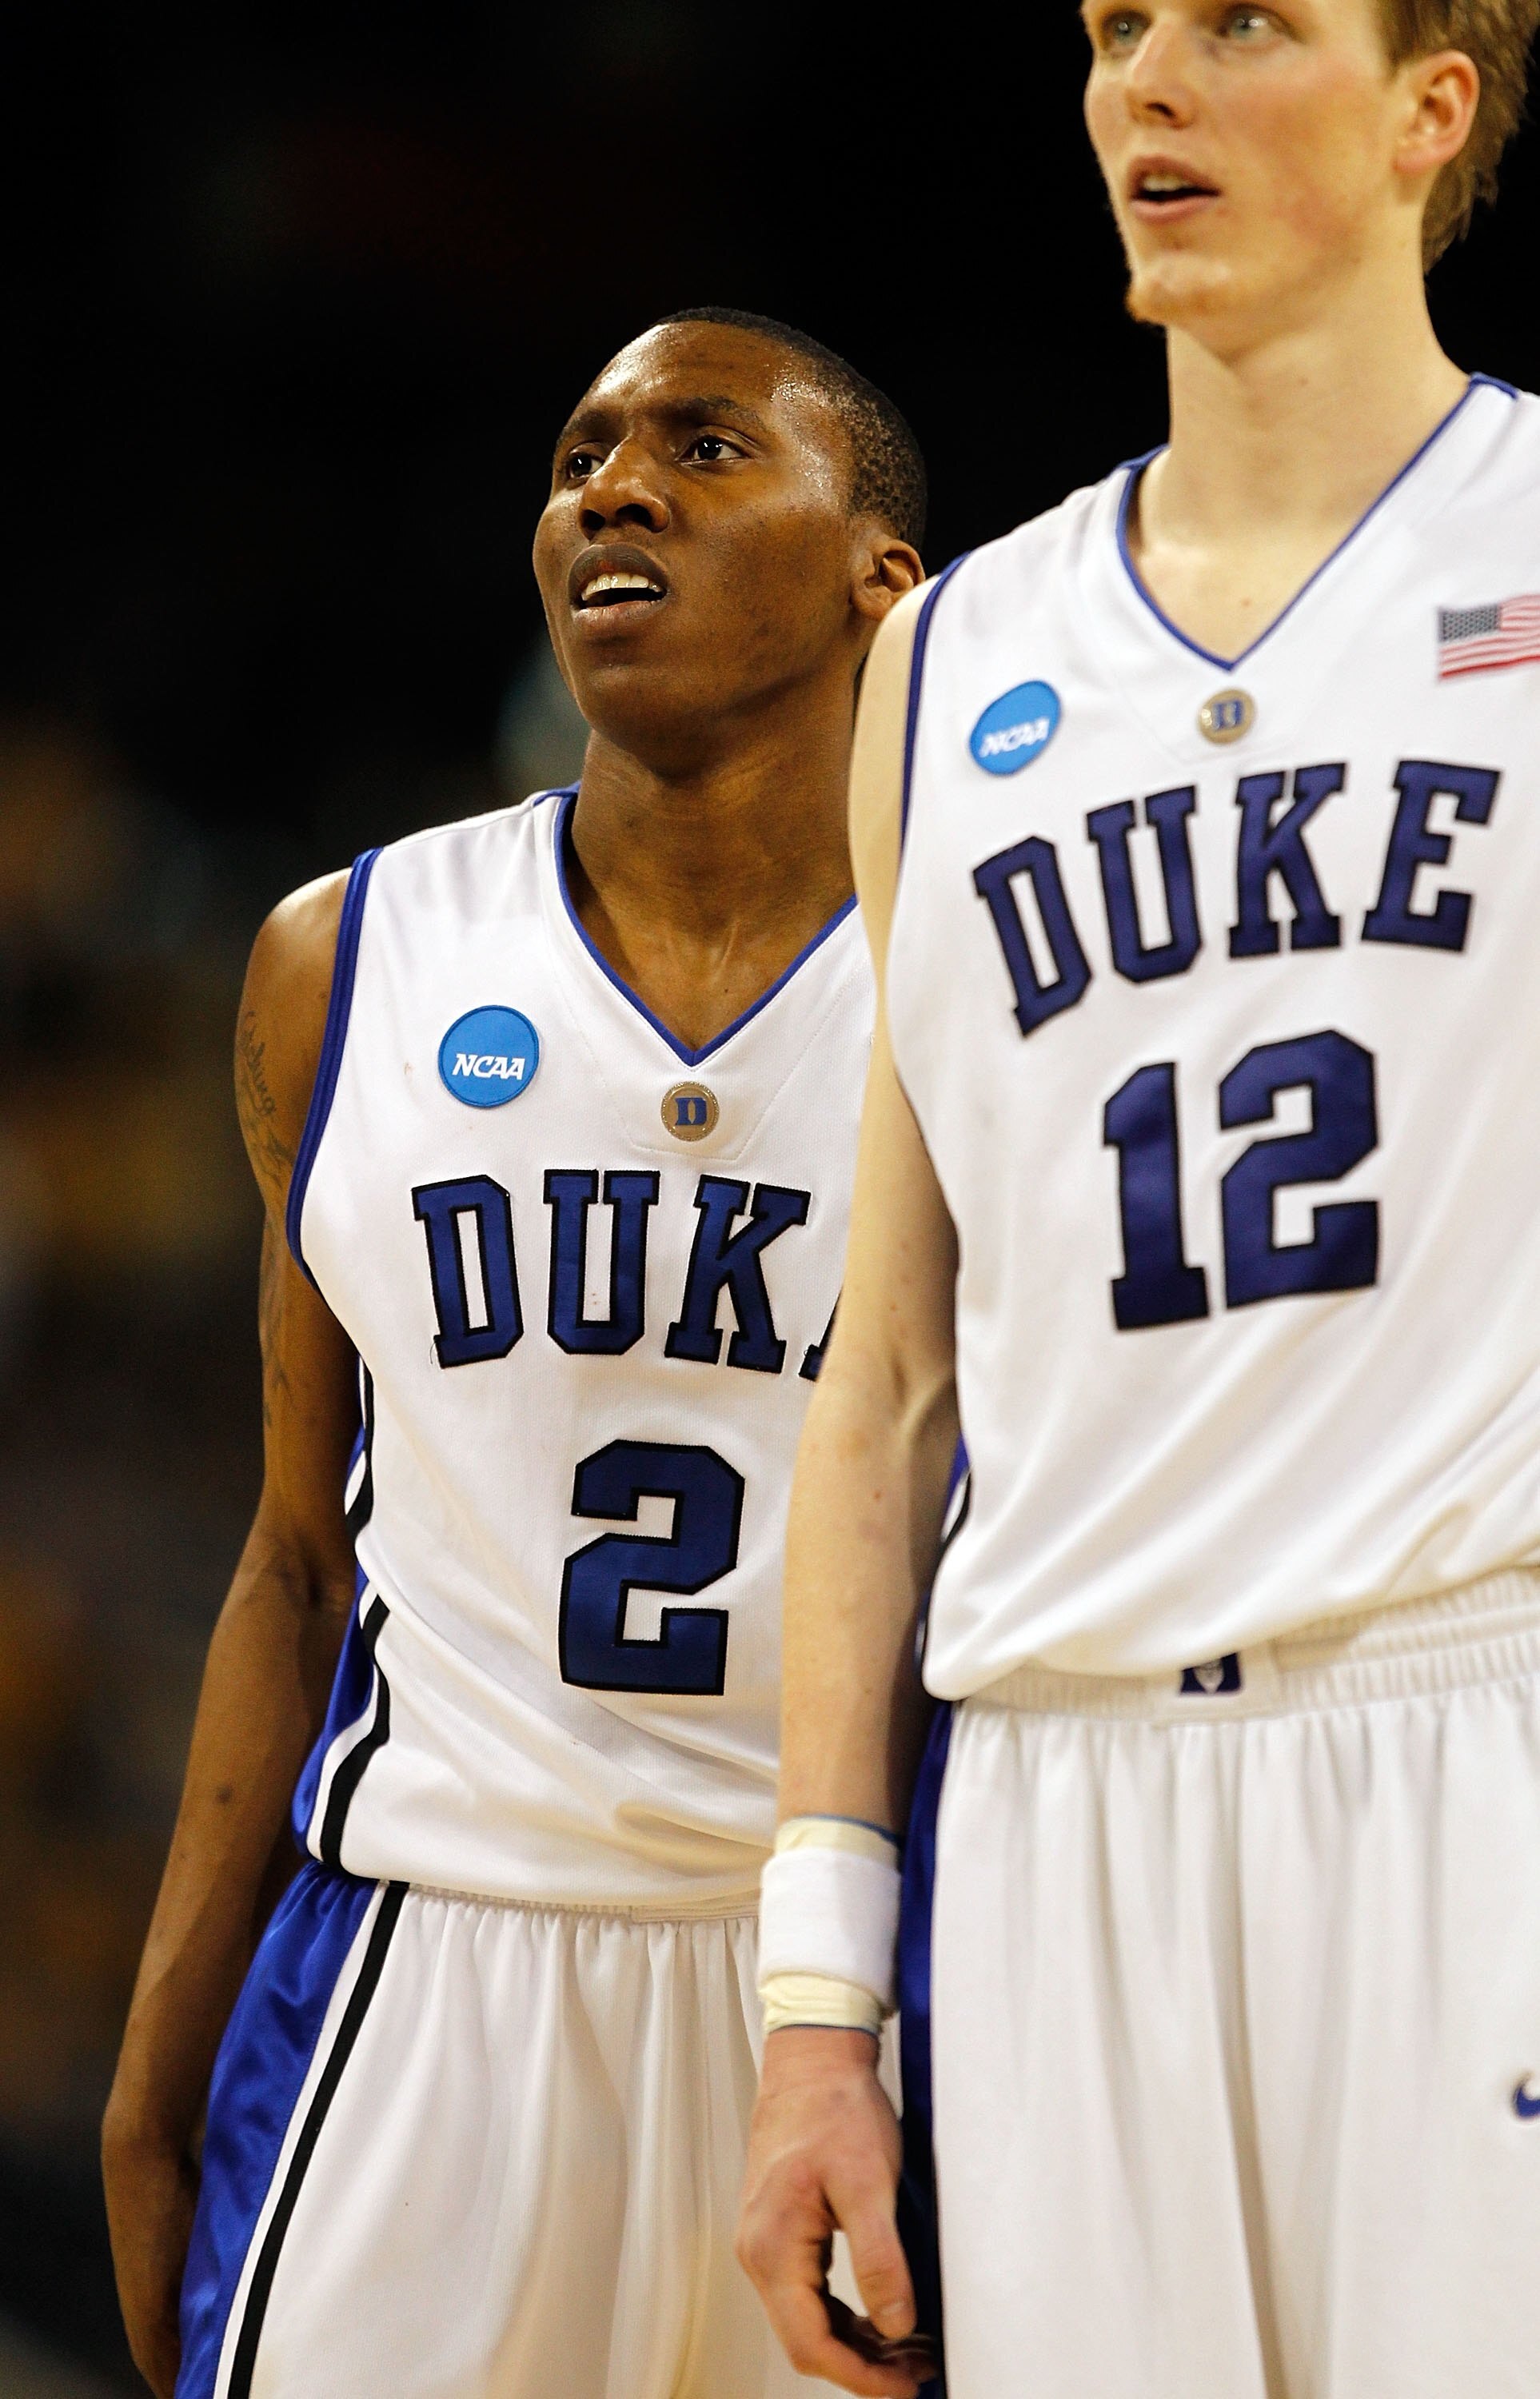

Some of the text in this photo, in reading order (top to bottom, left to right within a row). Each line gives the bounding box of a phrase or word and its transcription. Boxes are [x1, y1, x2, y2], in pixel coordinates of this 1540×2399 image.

[979, 717, 1050, 758] NCAA
[971, 759, 1502, 1039] DUKE
[452, 1052, 525, 1080] NCAA
[674, 1096, 708, 1126] D
[410, 1168, 843, 1382] DUK
[1103, 1029, 1379, 1331] 12
[558, 1439, 745, 1696] 2
